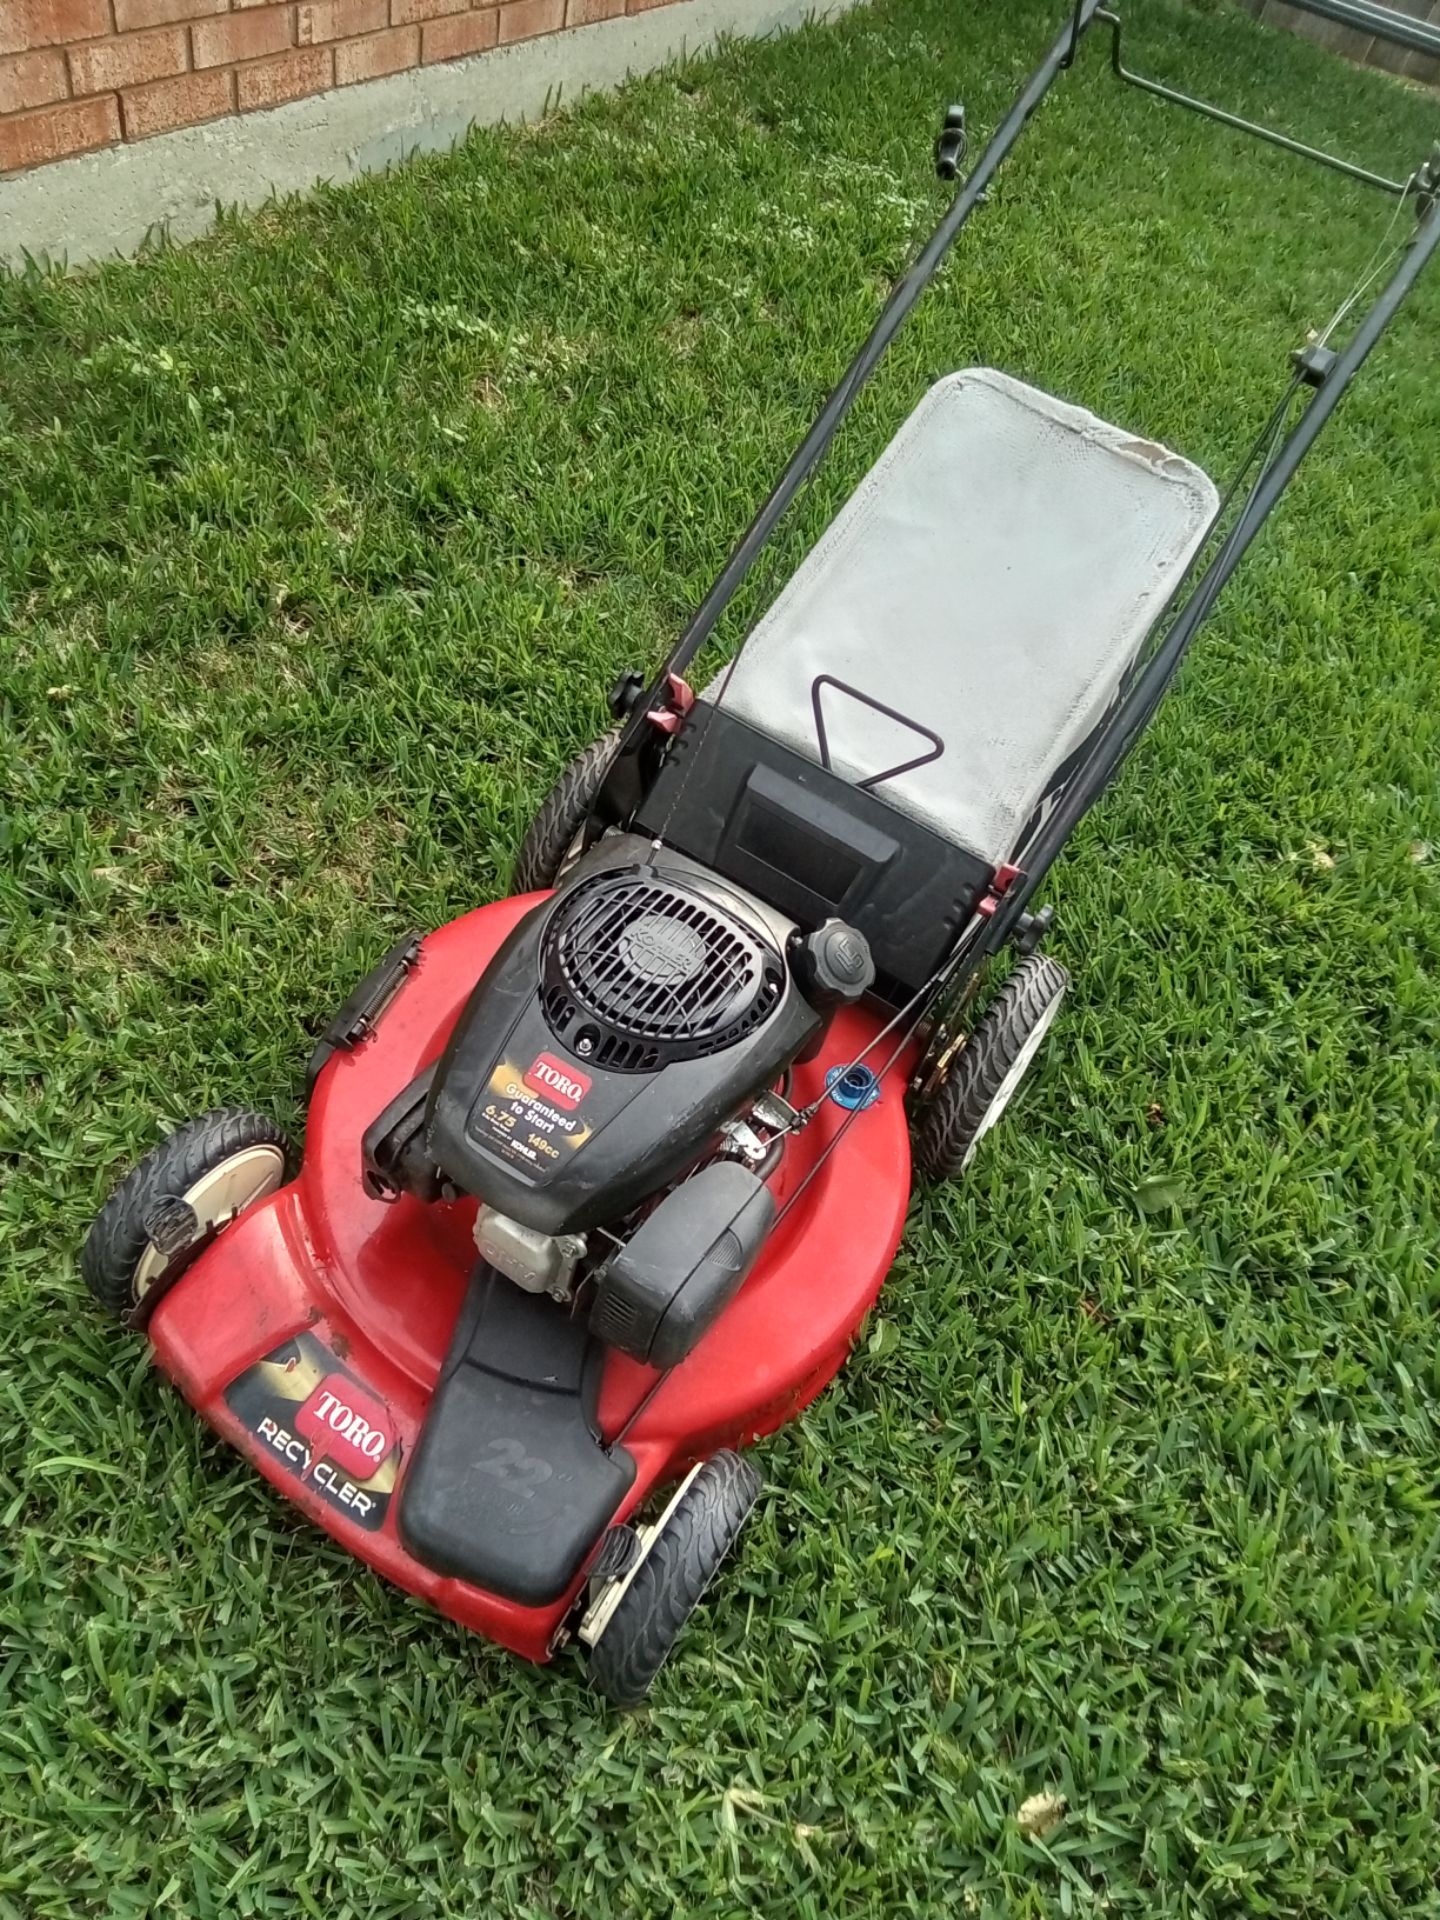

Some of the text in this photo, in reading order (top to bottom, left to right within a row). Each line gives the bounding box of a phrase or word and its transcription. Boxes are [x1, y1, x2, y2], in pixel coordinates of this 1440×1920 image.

[534, 1062, 582, 1101] TORO
[485, 1105, 517, 1127] 6.75
[506, 1083, 577, 1131] Guaranteed
[510, 1101, 524, 1115] to
[524, 1110, 555, 1133] Start
[528, 1133, 560, 1158] 149cc
[313, 1391, 385, 1457] TORO
[257, 1417, 373, 1517] RECYCLER
